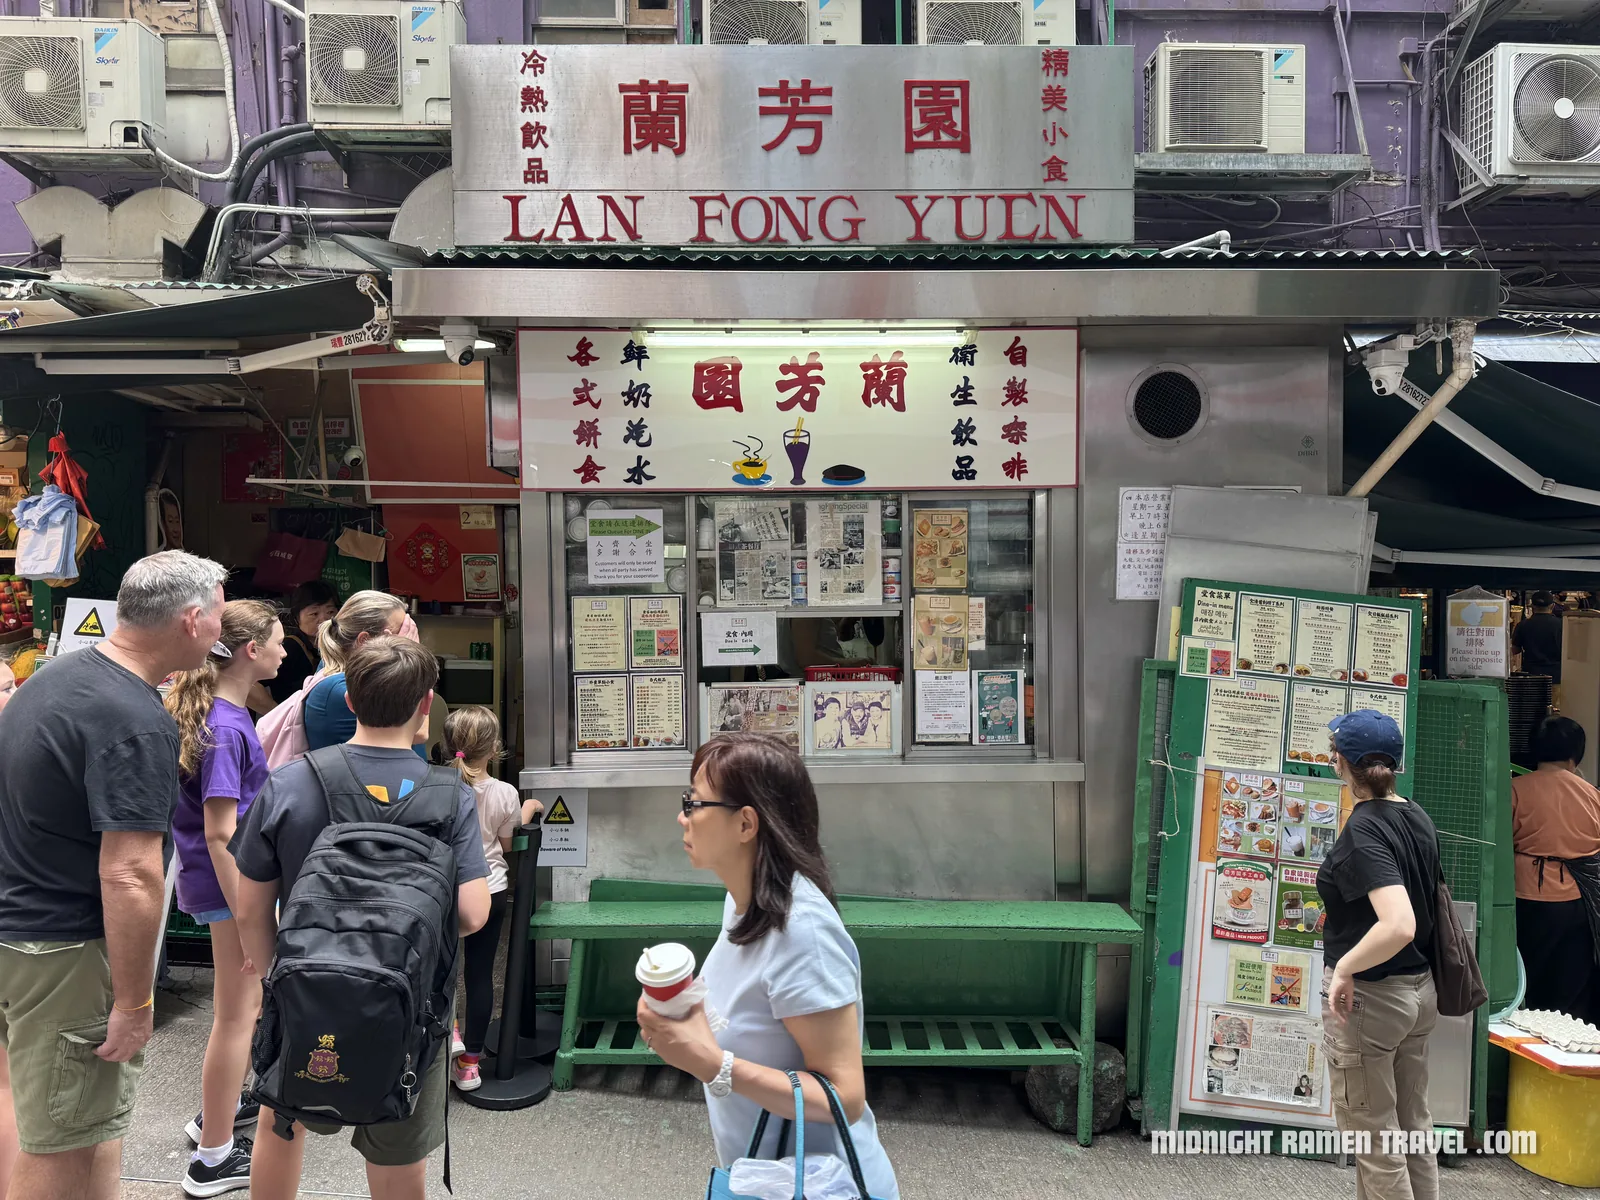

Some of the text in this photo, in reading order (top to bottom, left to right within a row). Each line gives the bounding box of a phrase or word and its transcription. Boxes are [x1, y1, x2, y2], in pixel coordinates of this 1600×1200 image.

[520, 49, 549, 184] 冷熱飲品
[618, 79, 971, 154] 蘭芳園
[1042, 49, 1069, 183] 精美小食
[502, 193, 1086, 243] LAN FONG YUEN
[566, 336, 607, 485] 各式餅食
[620, 339, 657, 484] 鮮奶汽水
[1197, 600, 1217, 608] Dine-in
[1456, 627, 1495, 637] 請往對面
[1465, 638, 1485, 647] 排隊
[1471, 656, 1502, 664] opposite
